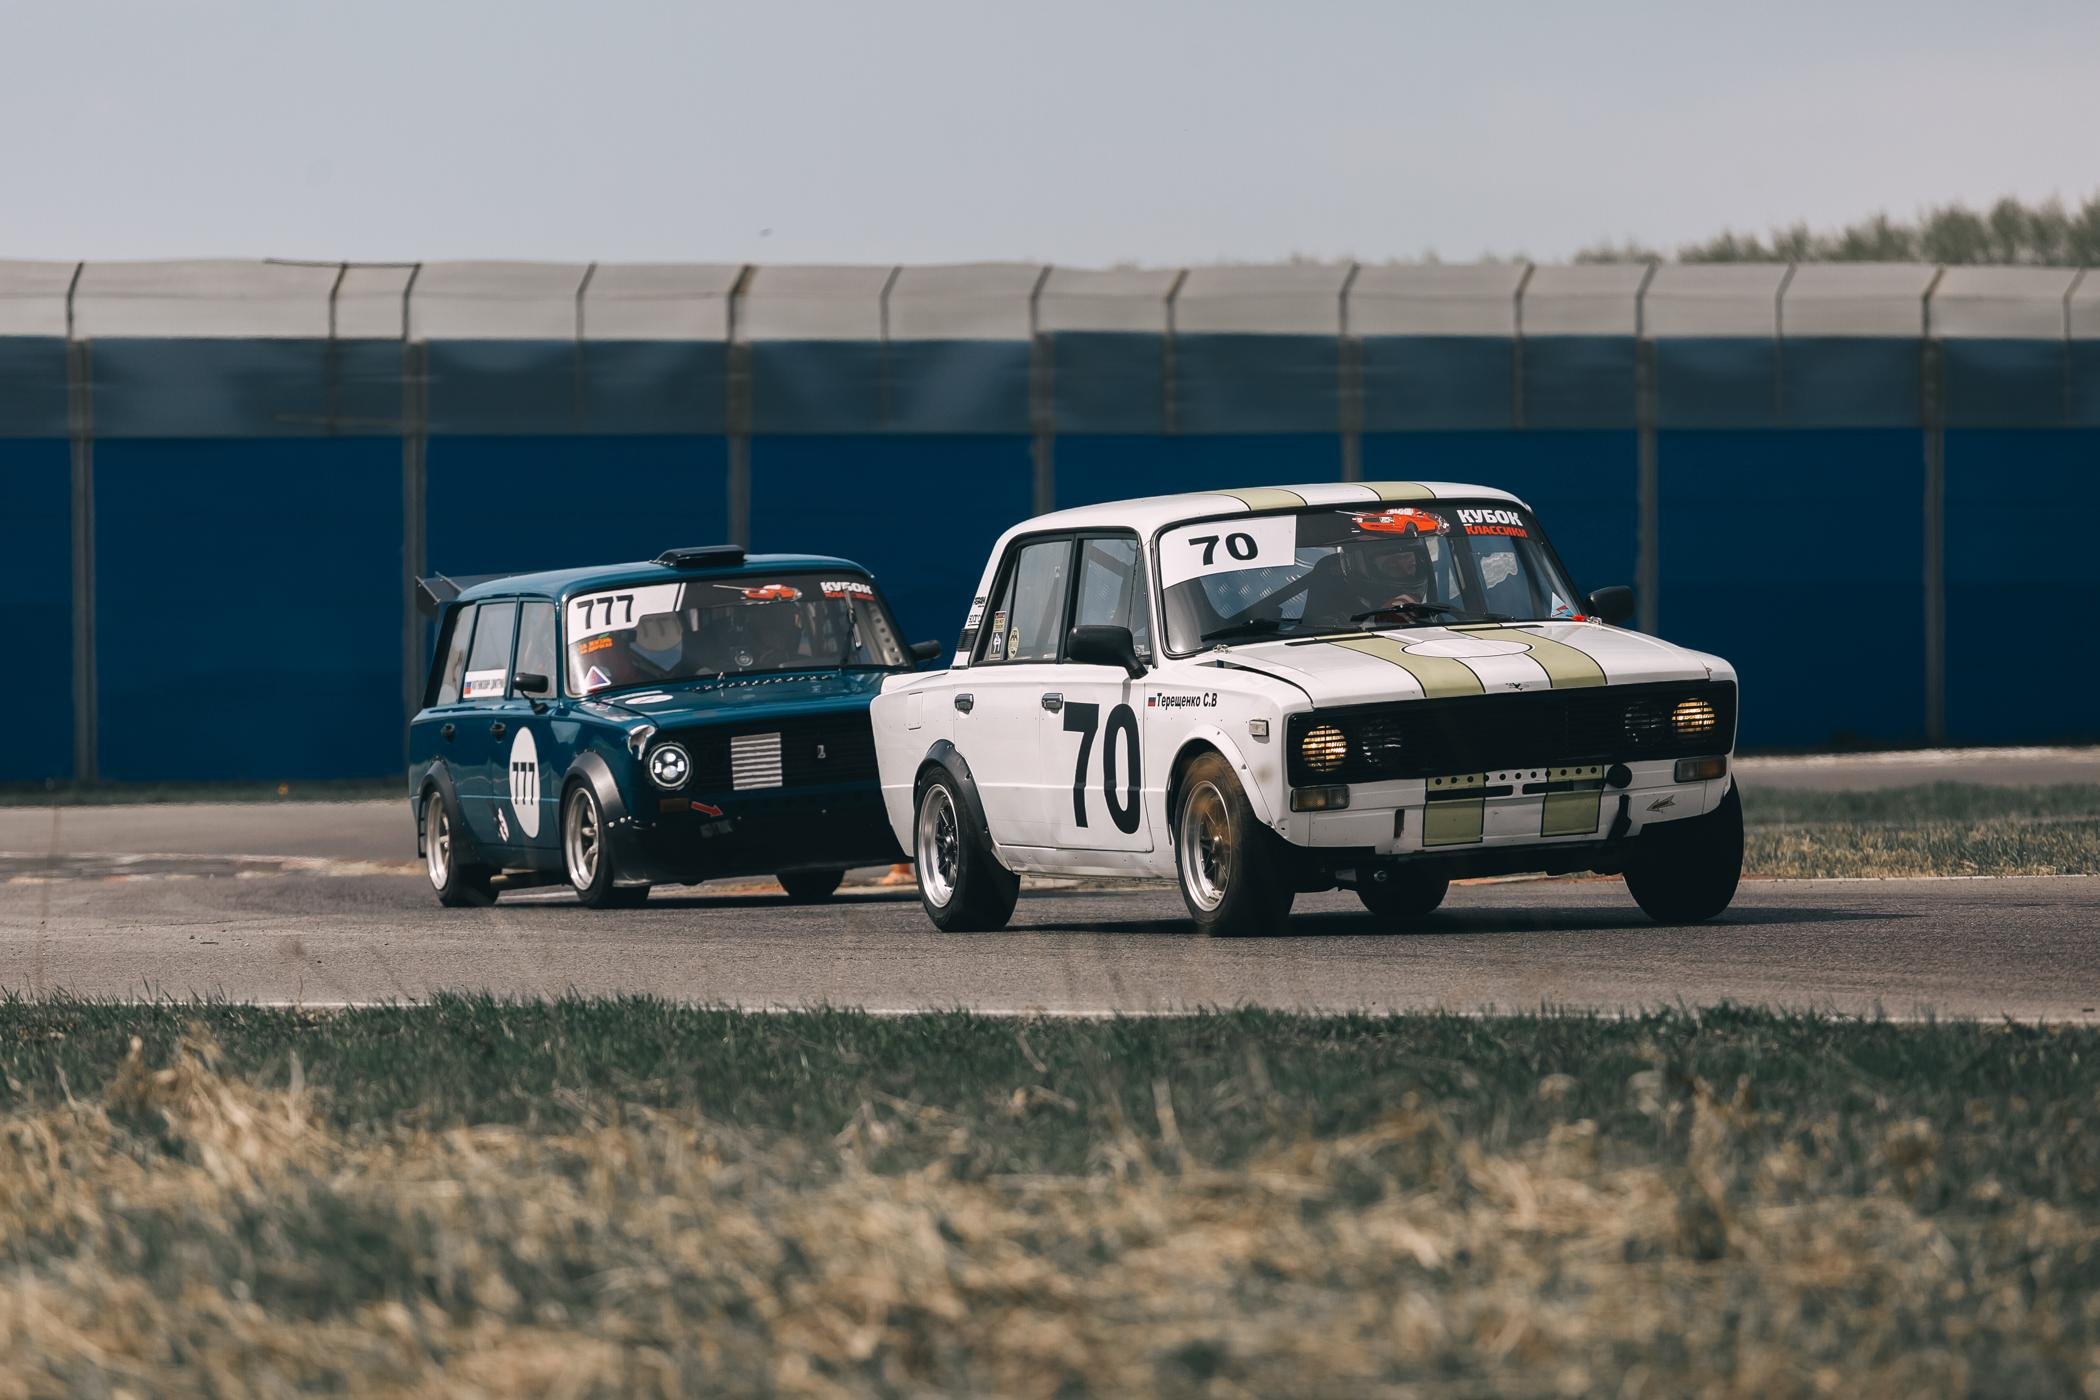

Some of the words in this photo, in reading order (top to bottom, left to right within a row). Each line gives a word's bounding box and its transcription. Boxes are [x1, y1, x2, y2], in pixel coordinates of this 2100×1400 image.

[1457, 510, 1523, 526] КУБОК
[1465, 525, 1528, 538] КЛАССИКИ
[1188, 533, 1258, 565] 70
[576, 594, 634, 629] 777
[1157, 692, 1201, 710] Терещенко
[1203, 692, 1217, 707] С.В
[512, 762, 535, 805] 777
[1063, 702, 1141, 834] 70
